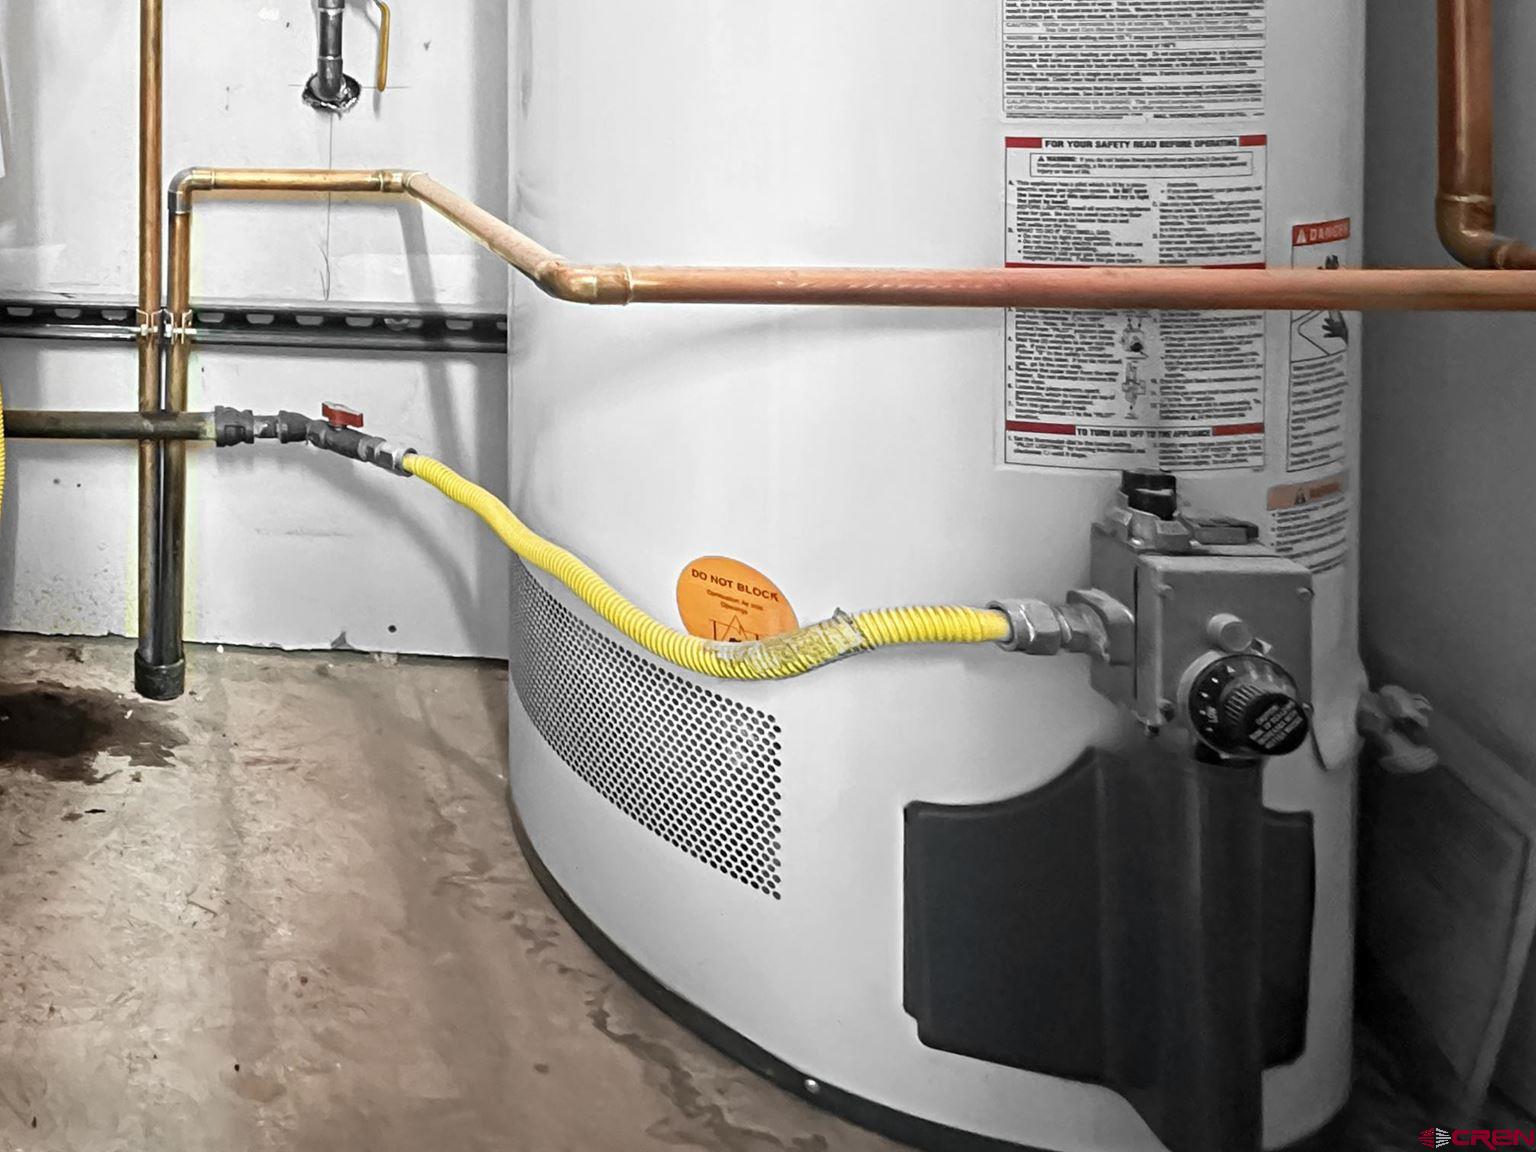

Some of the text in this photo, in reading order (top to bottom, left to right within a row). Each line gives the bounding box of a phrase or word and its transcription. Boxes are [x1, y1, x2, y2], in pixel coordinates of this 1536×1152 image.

[1045, 139, 1237, 148] FOR YOUR SAFETY READ BEFORE OPERATING
[1077, 428, 1087, 436] TO
[1090, 429, 1111, 437] TURN
[1112, 429, 1127, 437] GAS
[1130, 430, 1144, 438] OFF
[1158, 430, 1172, 438] THE
[1173, 429, 1211, 438] APPLIANCE
[691, 568, 708, 581] DO
[710, 575, 734, 588] NOT
[736, 582, 780, 602] BLOCK
